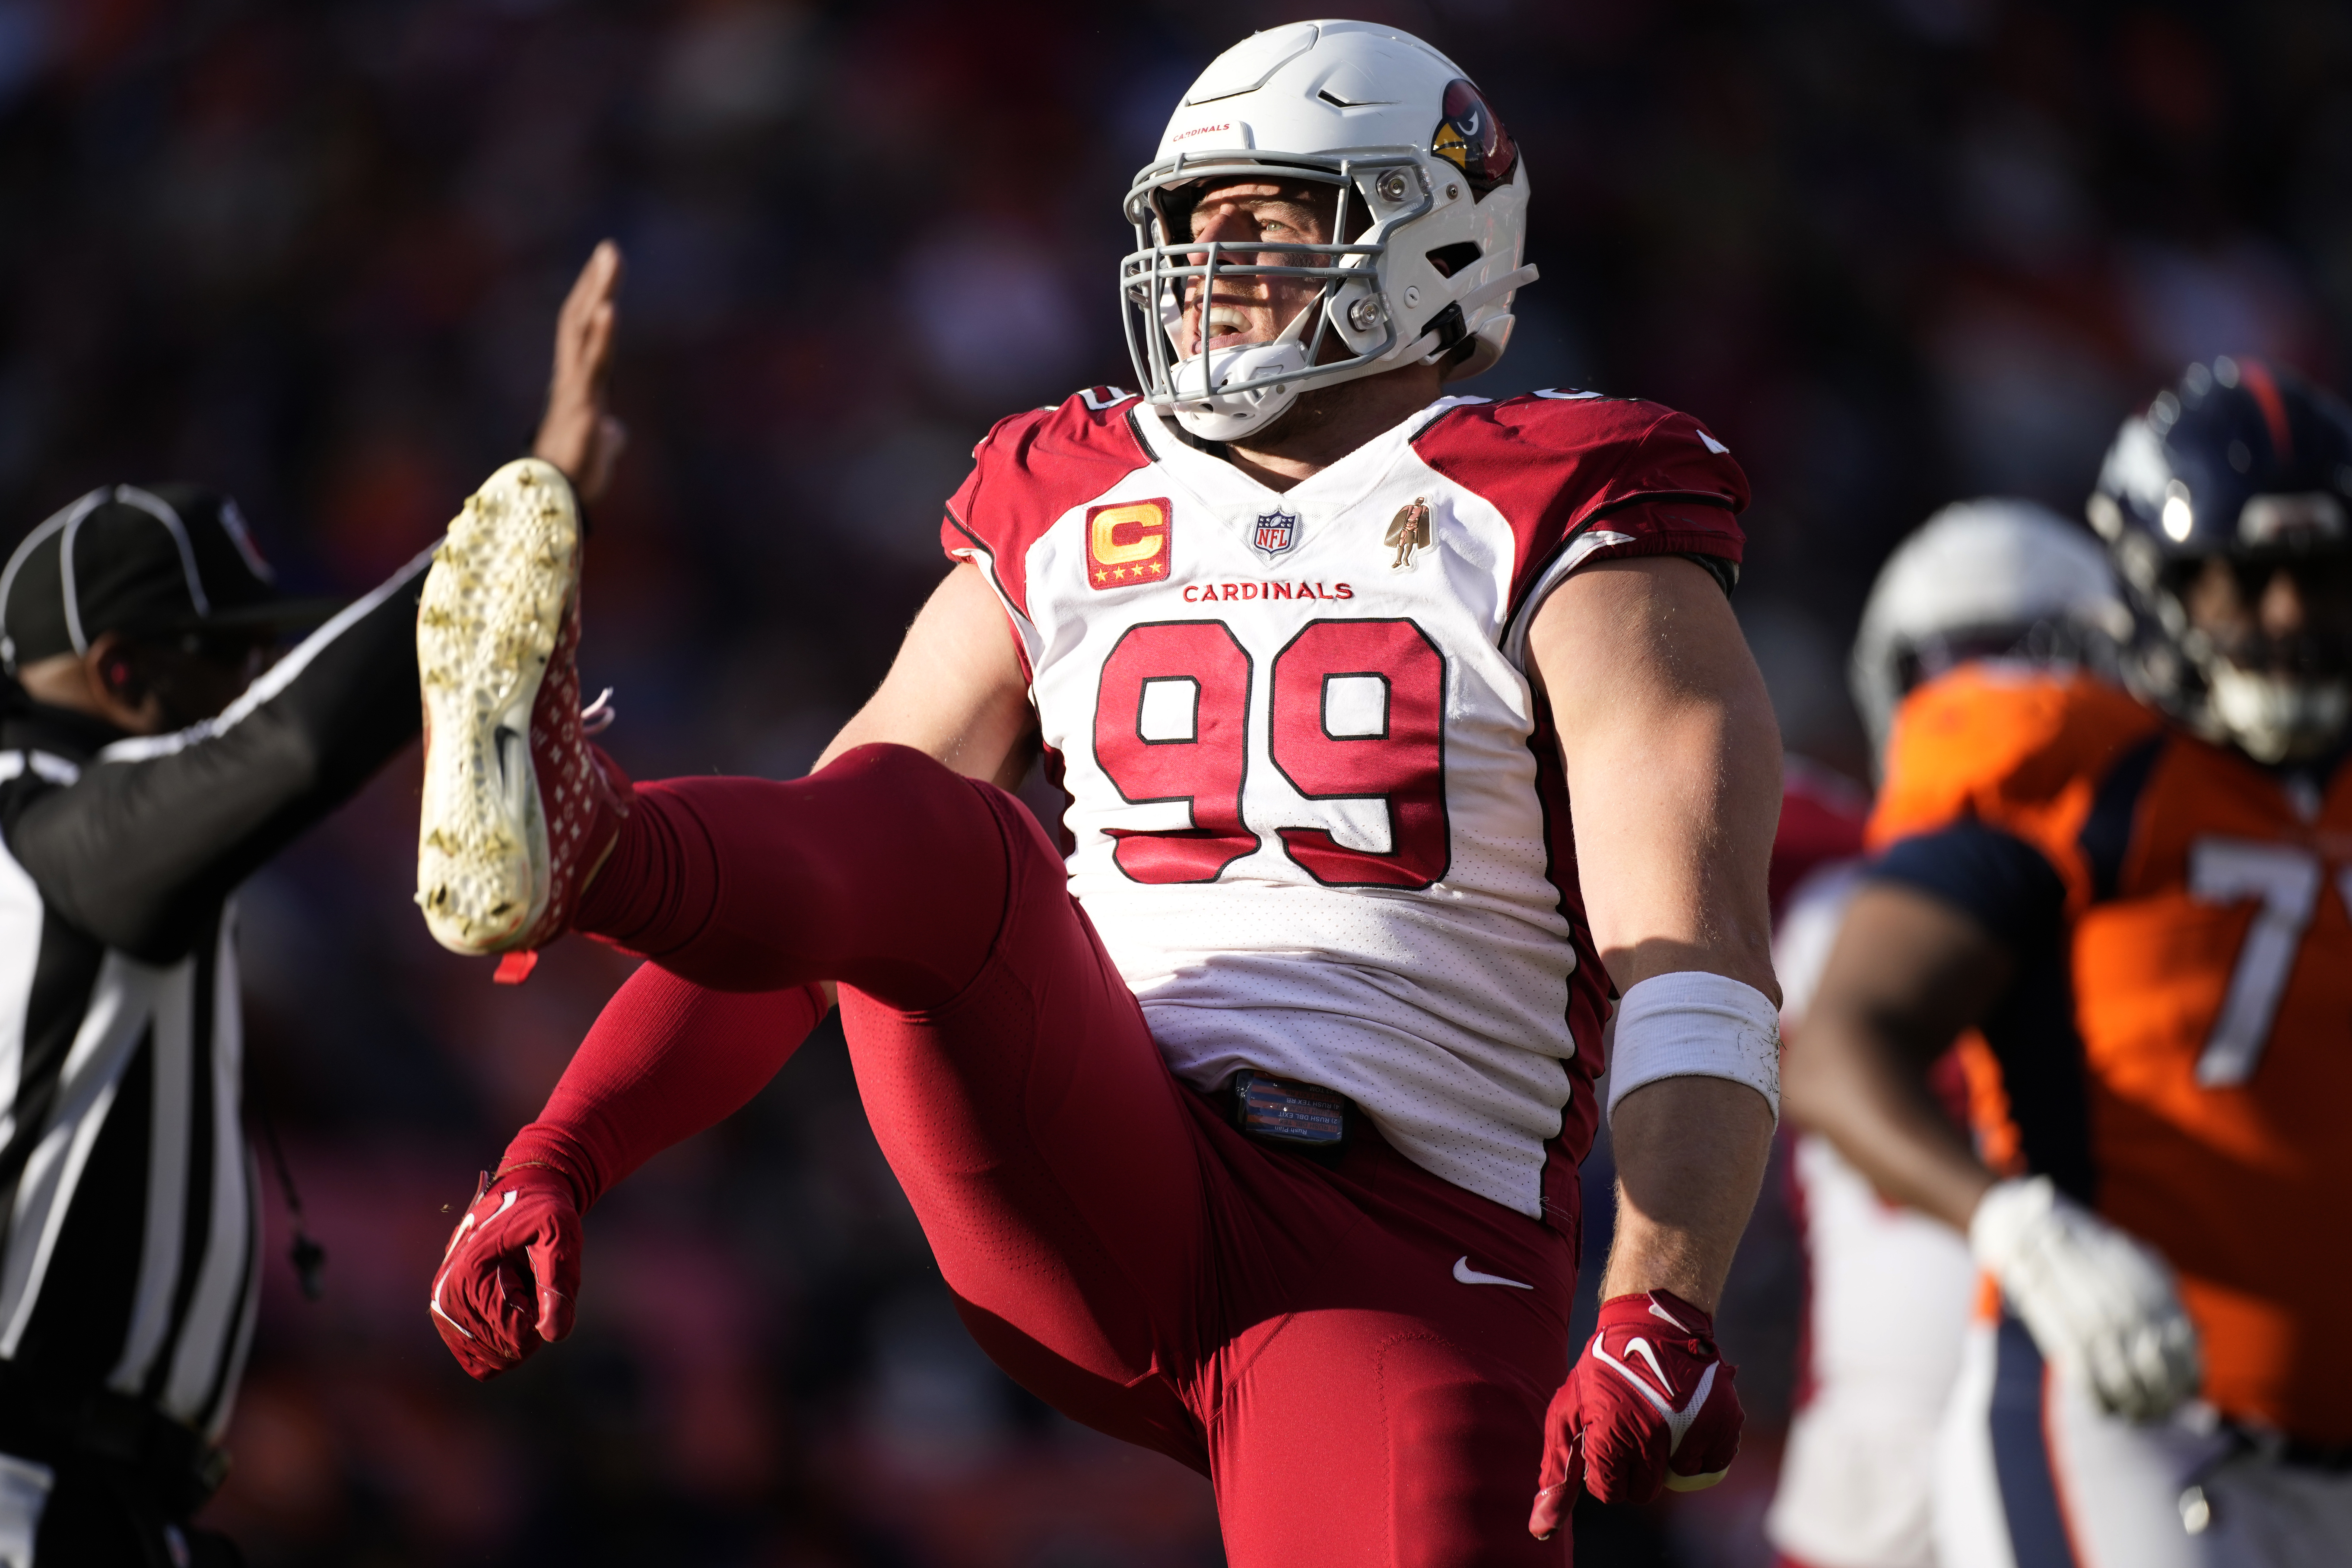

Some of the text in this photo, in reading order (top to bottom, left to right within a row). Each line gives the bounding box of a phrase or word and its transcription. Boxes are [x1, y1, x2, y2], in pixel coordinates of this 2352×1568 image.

[1173, 124, 1230, 142] CARDINALS
[1092, 504, 1163, 565] C
[1257, 529, 1287, 549] NFL
[1183, 582, 1355, 603] CARDINALS
[1092, 617, 1451, 891] 99
[2188, 832, 2352, 1091] 7
